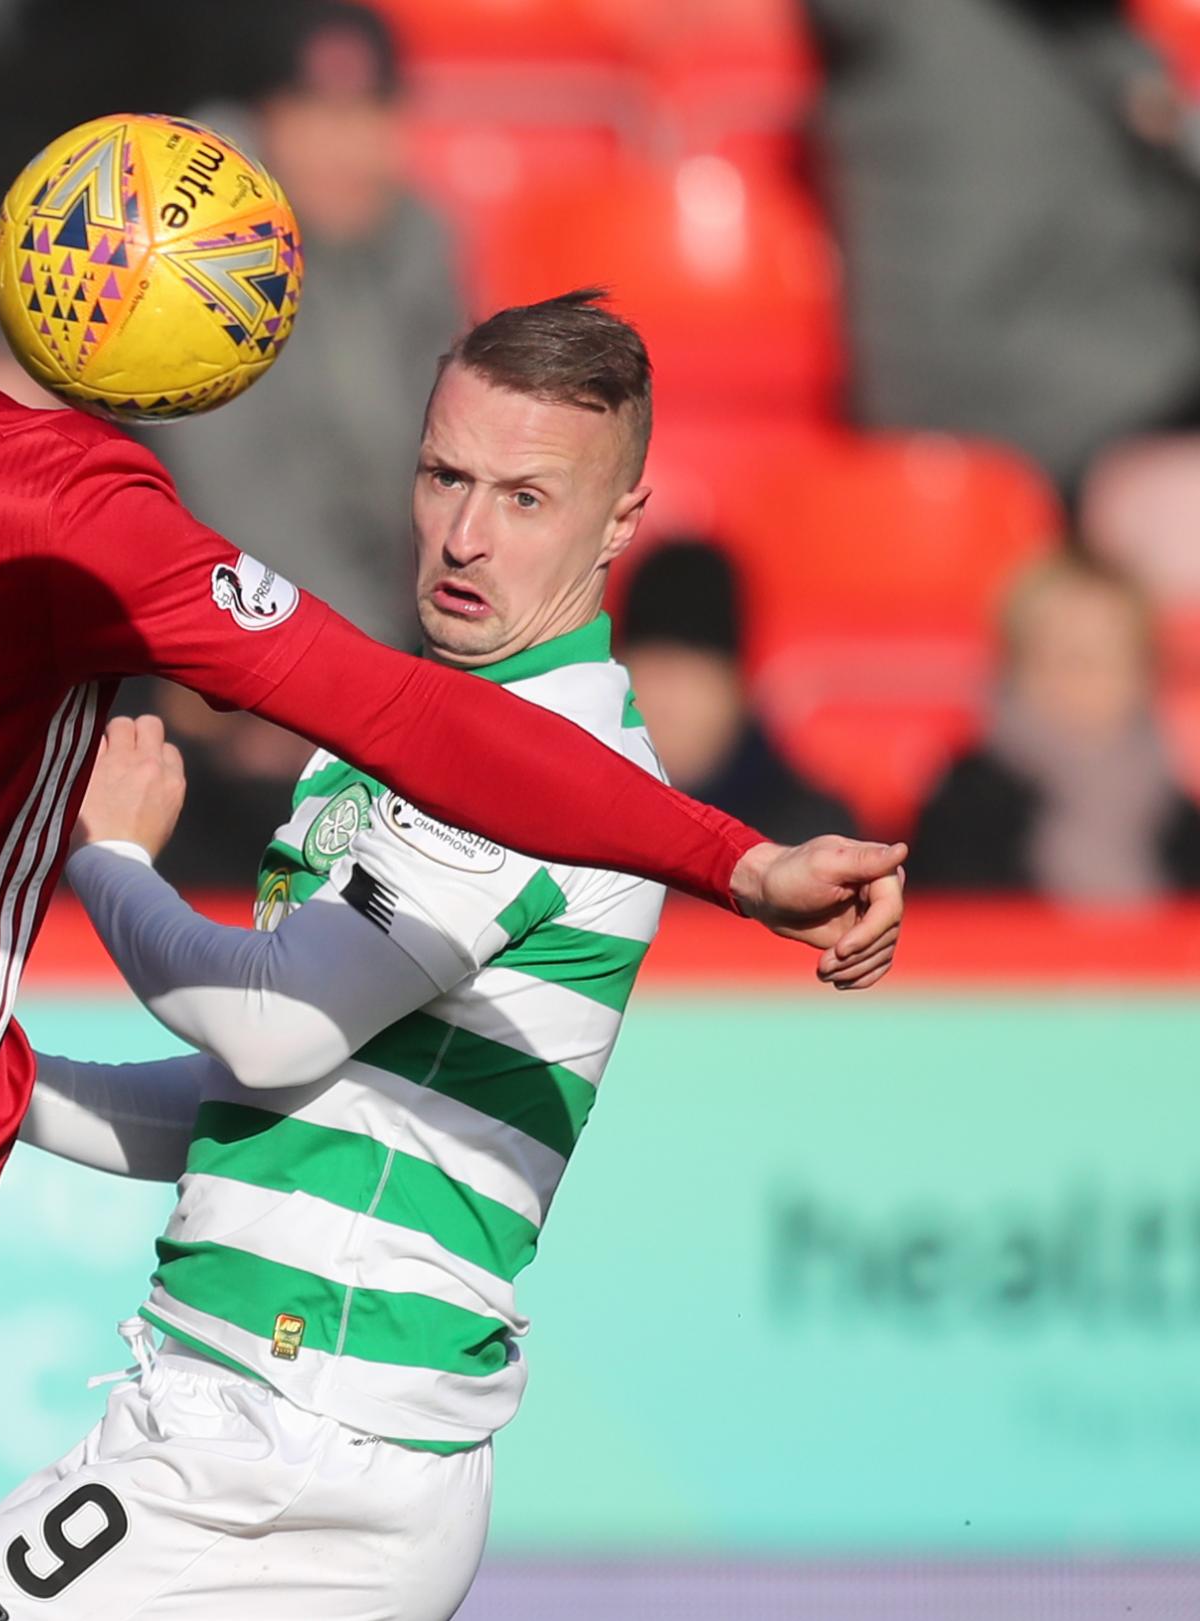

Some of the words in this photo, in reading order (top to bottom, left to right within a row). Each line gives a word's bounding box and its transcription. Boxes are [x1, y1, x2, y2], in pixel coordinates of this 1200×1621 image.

[160, 142, 225, 229] mitre
[413, 817, 477, 859] CHAMPIONS
[6, 1482, 128, 1599] 9
